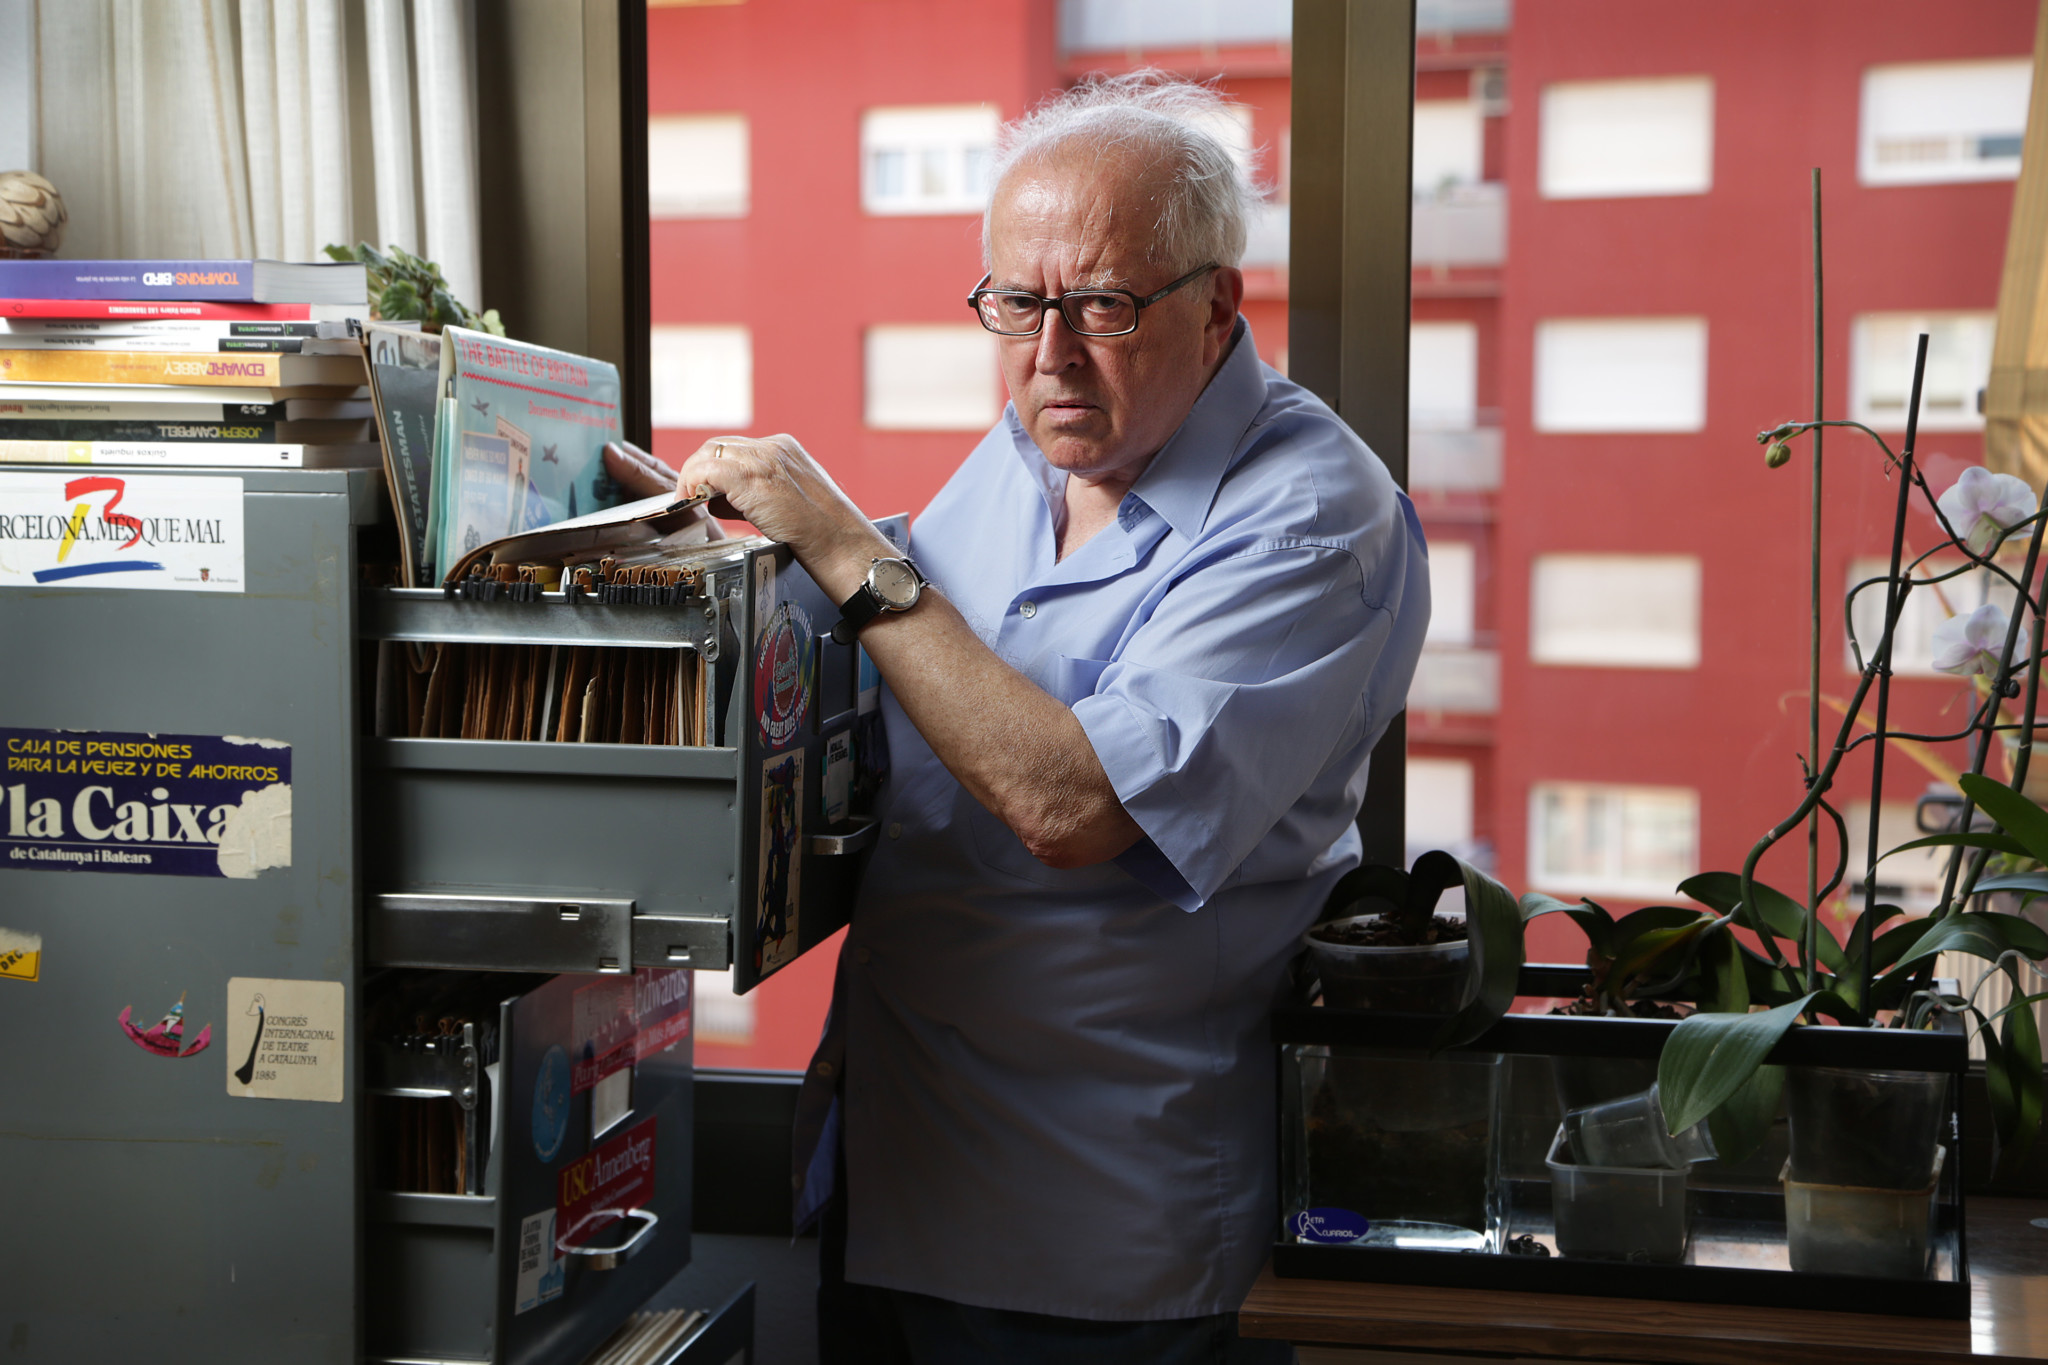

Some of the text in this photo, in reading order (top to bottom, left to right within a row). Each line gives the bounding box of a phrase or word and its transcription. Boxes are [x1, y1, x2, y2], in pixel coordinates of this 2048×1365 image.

[143, 272, 172, 286] BIRD
[176, 272, 239, 286] TOMPKINS
[164, 361, 209, 375] ABBEY
[208, 363, 265, 376] EDWARD
[458, 338, 590, 388] THE BATTLE OF BRITAIN
[157, 426, 219, 438] CAMPBELL
[218, 427, 262, 439] JOSEPH
[392, 410, 424, 530] STATESMAN
[141, 517, 181, 547] QUE
[8, 738, 192, 759] CAJA DE PENSIONES
[8, 757, 279, 781] PARA LA VEJEZ Y DE AHORROS
[72, 785, 239, 844] Caixa
[10, 847, 152, 865] de Catalunya i Balears
[635, 967, 688, 1016] Edwards
[265, 1013, 308, 1026] CONGRÉS
[264, 1028, 336, 1041] INTERNACIONAL
[262, 1041, 309, 1052] DE TEATRE
[258, 1054, 318, 1066] A CATALUNYA
[563, 1158, 592, 1207] USC
[591, 1135, 651, 1192] Annenberg
